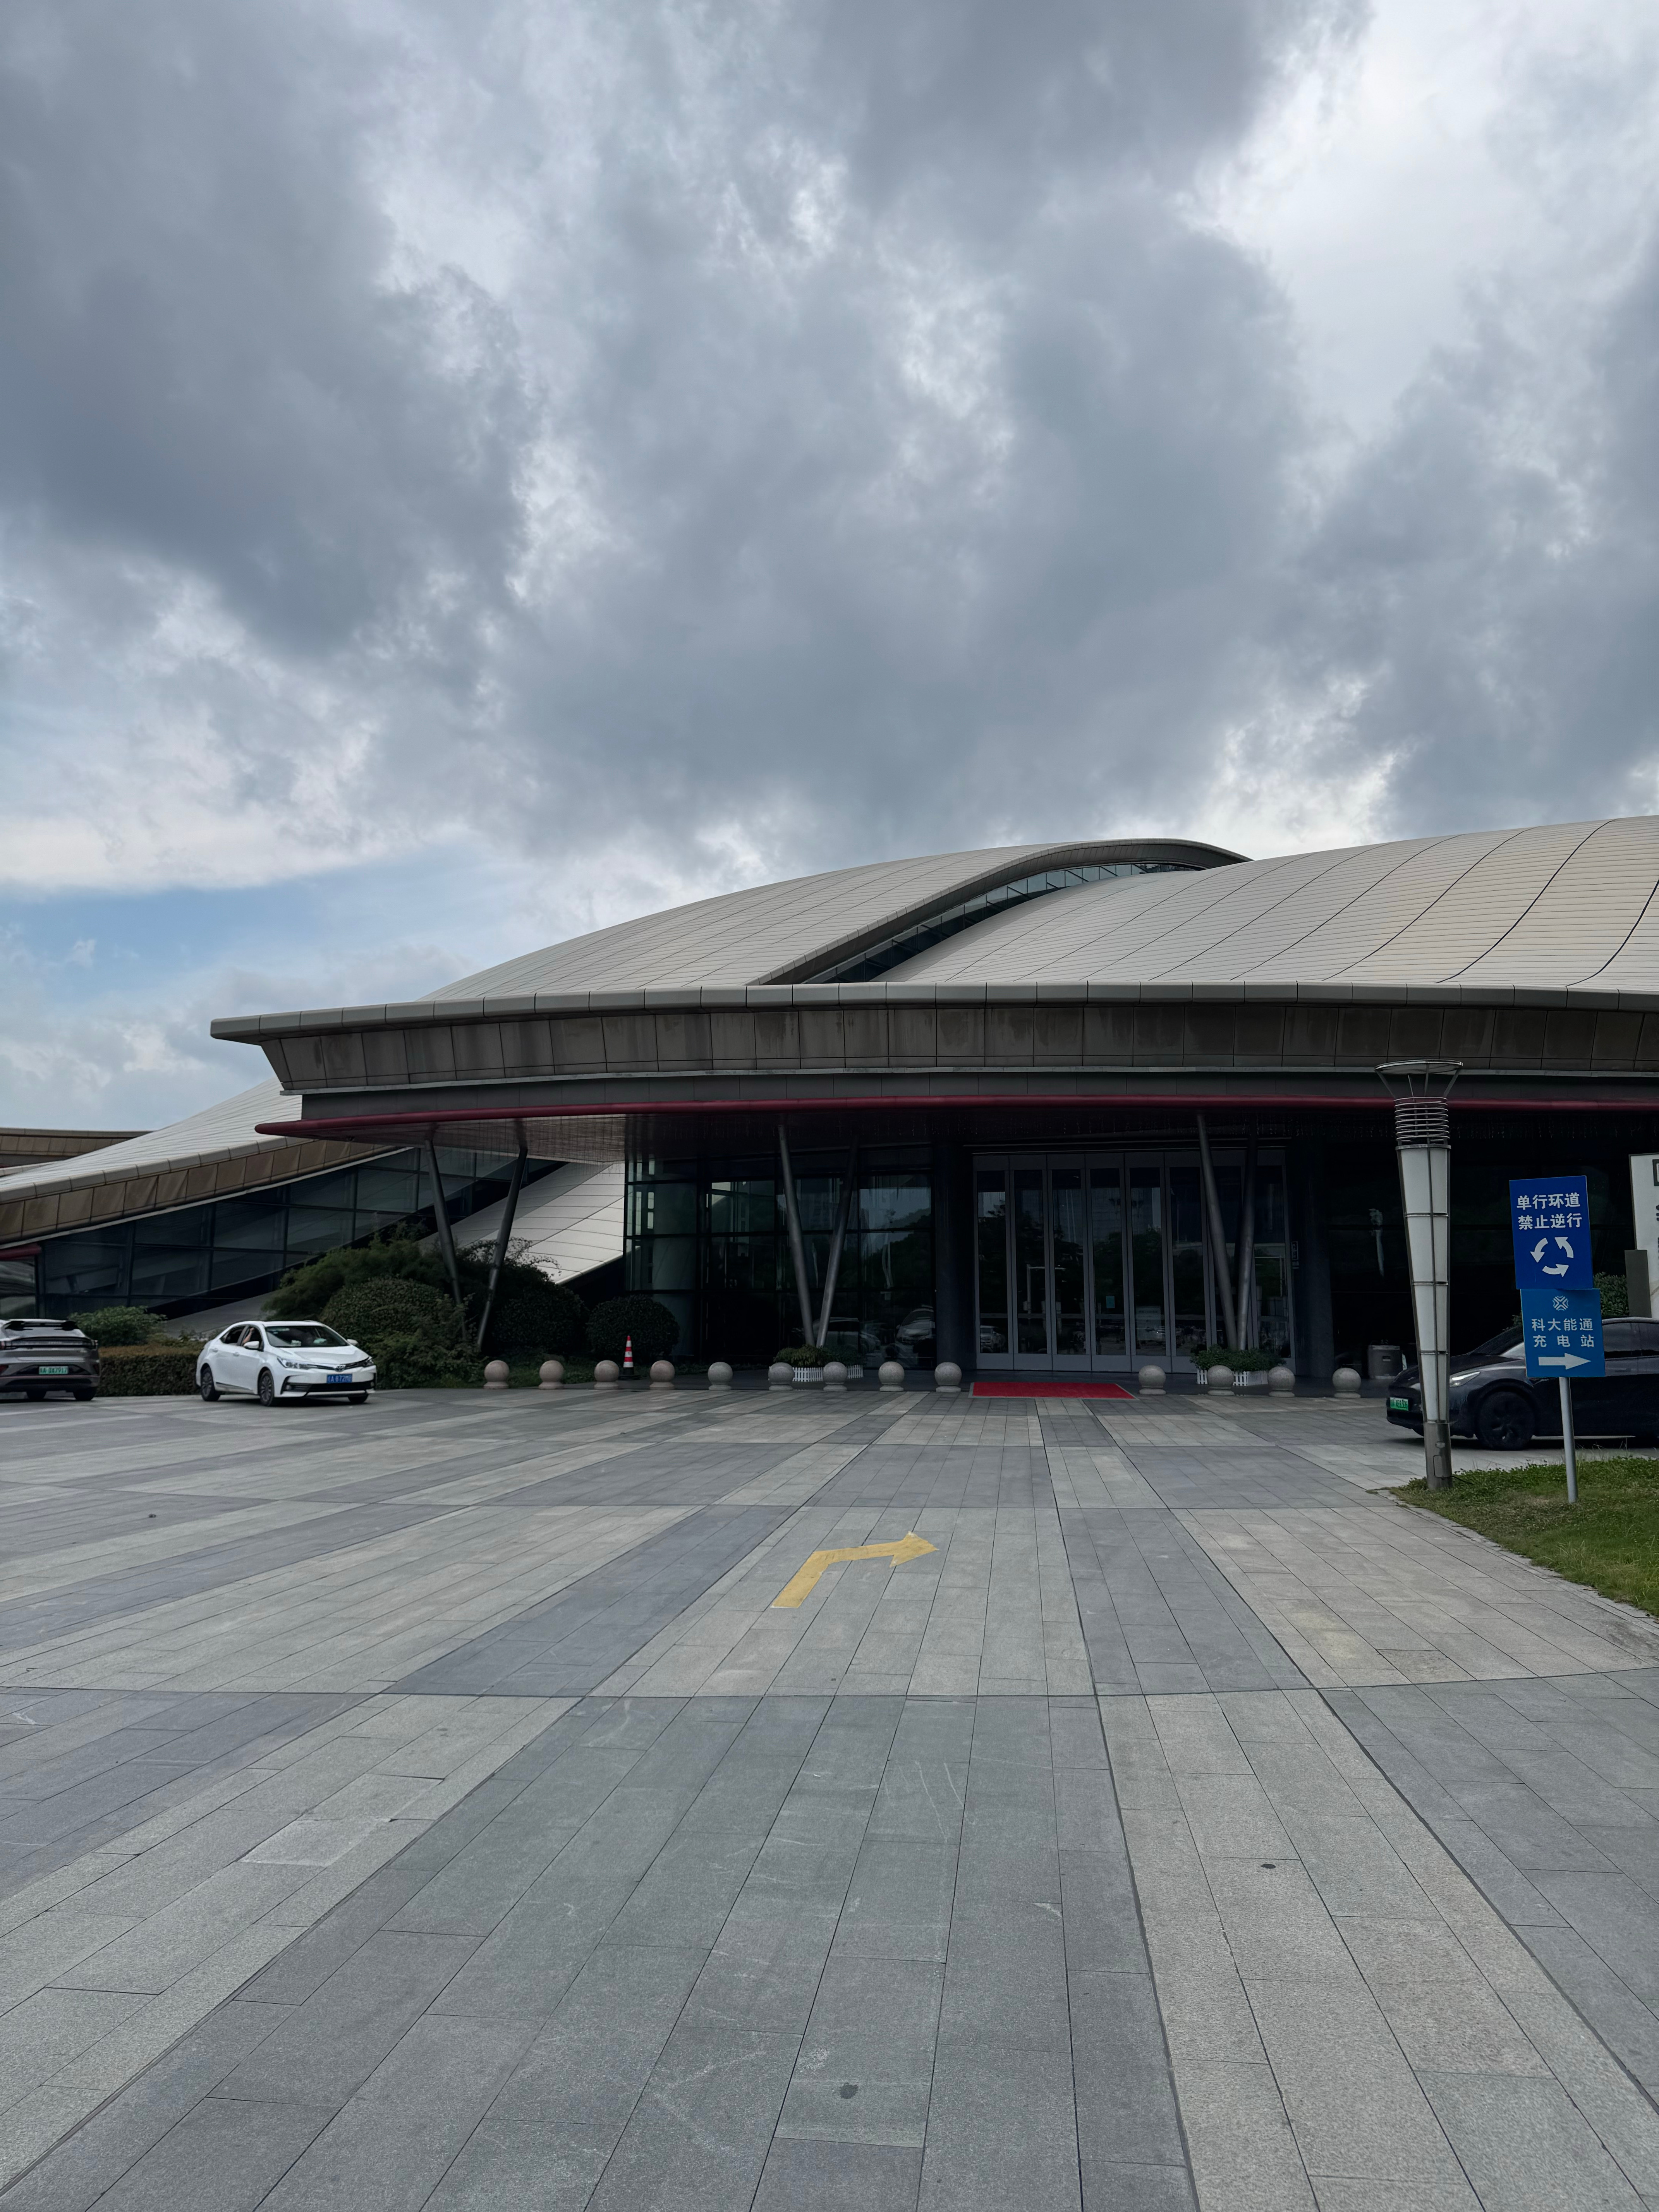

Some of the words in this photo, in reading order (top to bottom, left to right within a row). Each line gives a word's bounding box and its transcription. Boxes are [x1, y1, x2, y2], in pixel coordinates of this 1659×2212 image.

[1516, 1192, 1580, 1210] 单行环道
[1518, 1213, 1582, 1230] 禁止逆行
[1531, 1318, 1593, 1331] 科大能通
[1533, 1334, 1594, 1348] 充电站
